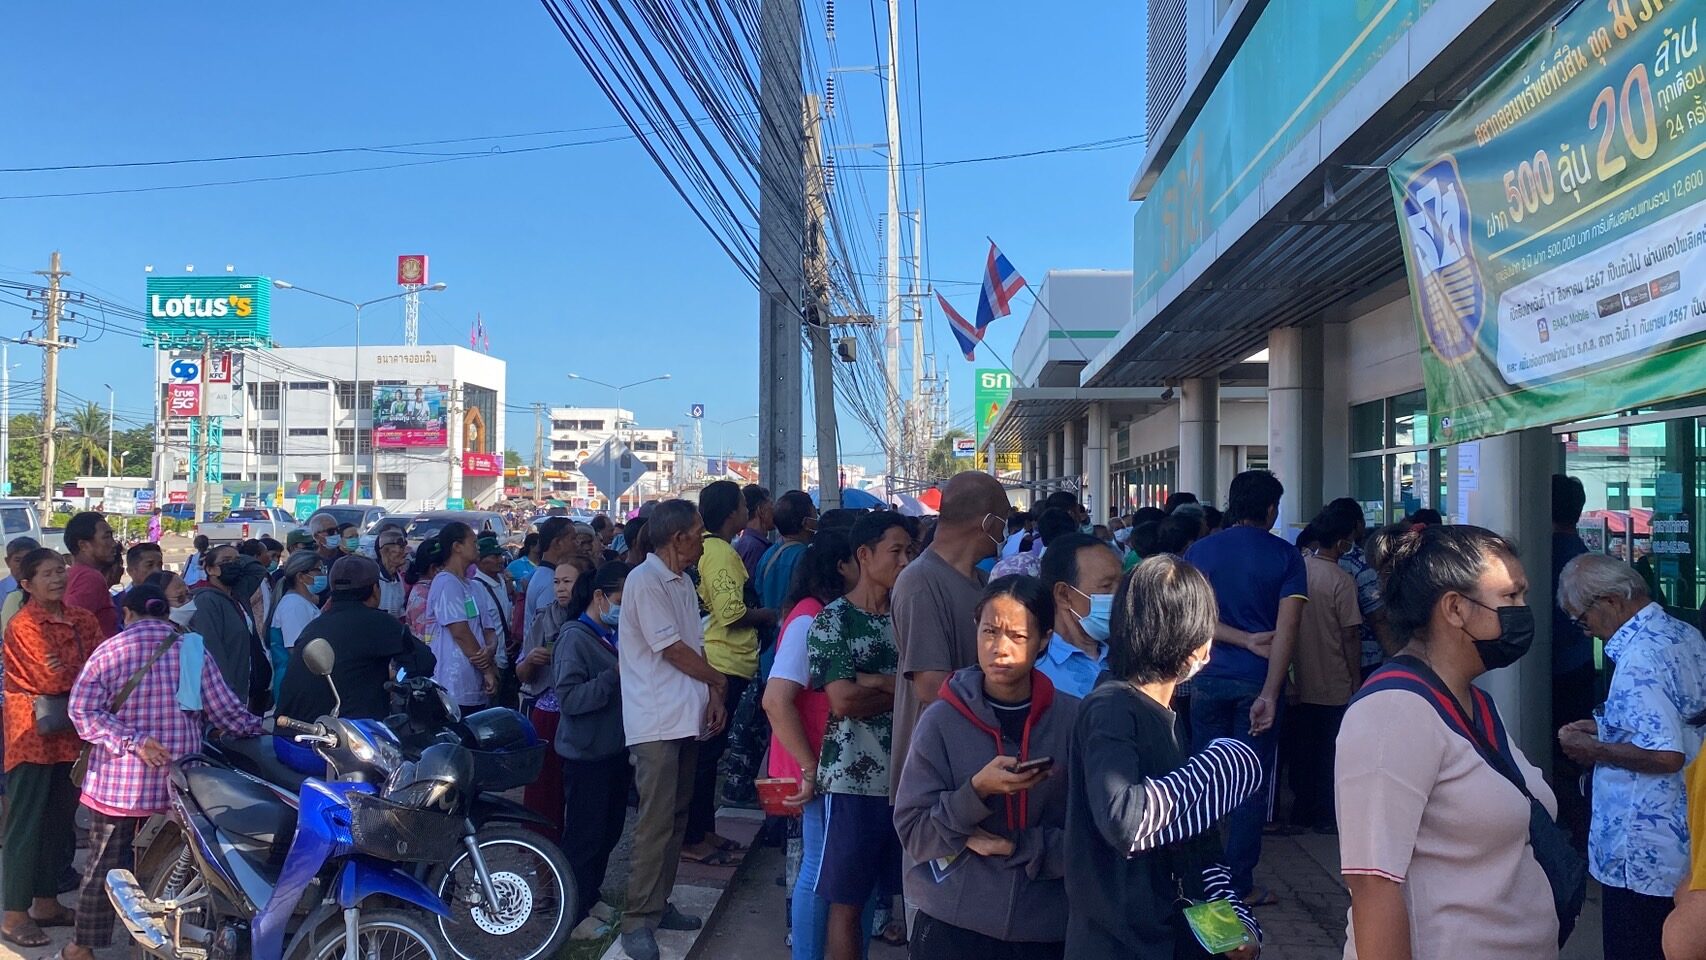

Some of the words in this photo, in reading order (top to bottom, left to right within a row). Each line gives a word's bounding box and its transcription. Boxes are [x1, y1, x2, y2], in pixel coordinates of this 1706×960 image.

[1587, 27, 1612, 66] ชุด
[1657, 65, 1705, 112] ทุกเดือน
[1486, 207, 1509, 239] ฝาก
[1503, 150, 1555, 223] 500
[1557, 143, 1592, 204] ลุ้น
[1588, 63, 1658, 182] 20
[1654, 17, 1698, 77] ล้าน
[1666, 113, 1685, 140] 24
[1548, 233, 1576, 259] 500,000
[1672, 169, 1704, 198] 12,600
[1547, 292, 1555, 306] 17
[1585, 270, 1605, 291] 2567
[151, 294, 252, 317] Lotus's
[1668, 304, 1688, 325] 2567
[171, 397, 195, 409] 5G
[173, 388, 195, 398] true
